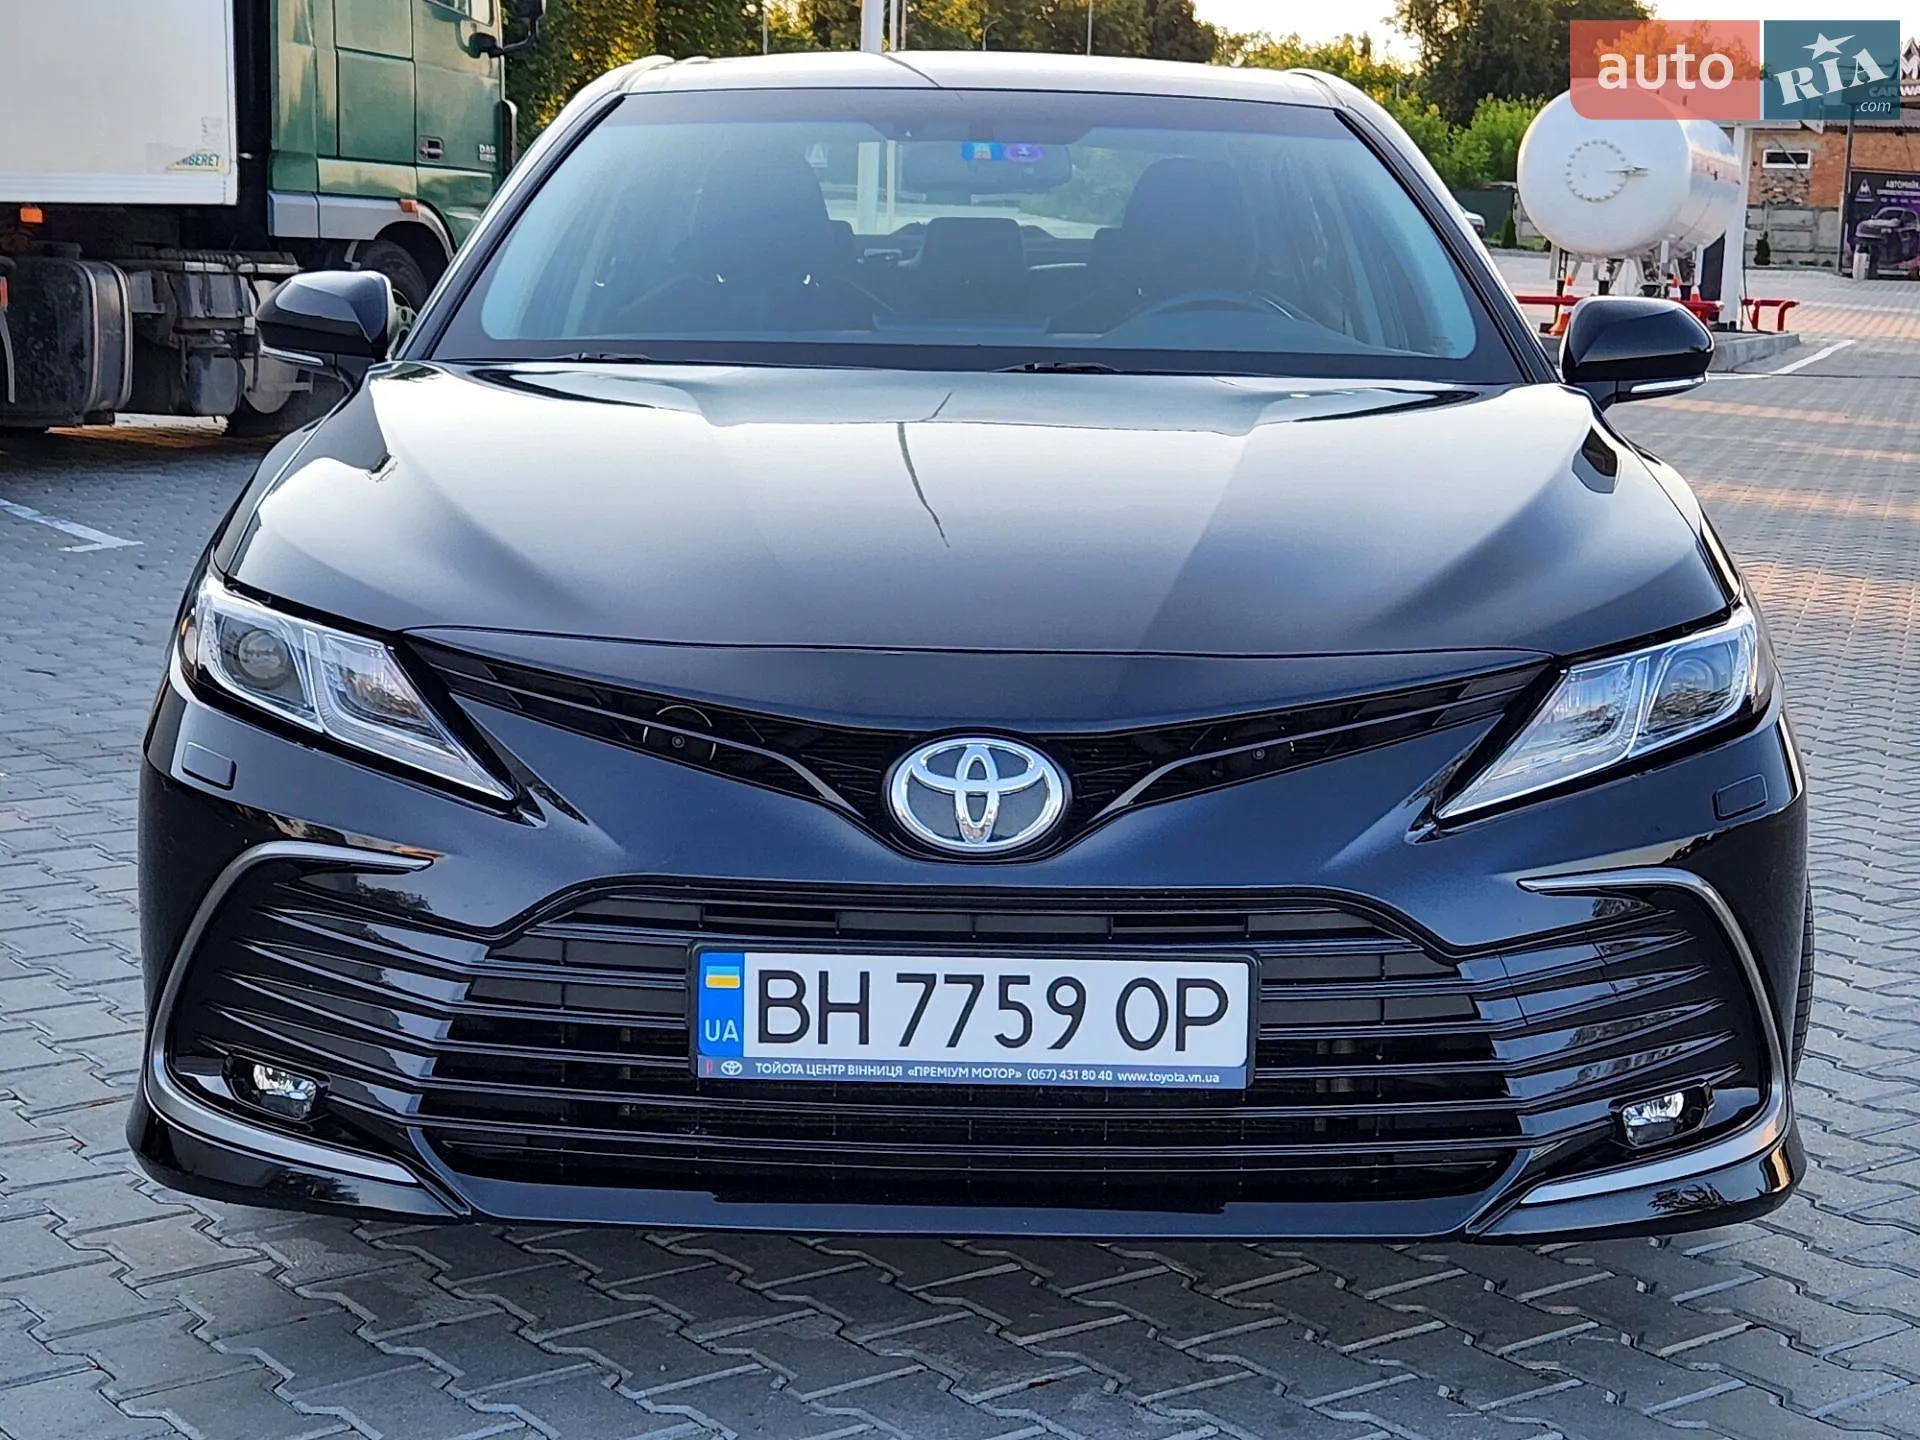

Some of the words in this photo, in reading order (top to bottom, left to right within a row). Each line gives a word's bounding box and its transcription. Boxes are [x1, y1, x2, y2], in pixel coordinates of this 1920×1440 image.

[758, 969, 871, 1046] BH
[896, 972, 1087, 1051] 7759
[1115, 976, 1230, 1052] OP
[705, 1018, 740, 1043] UA
[755, 1061, 805, 1075] ТОЙОТА
[806, 1063, 846, 1077] ЦЕНТР
[847, 1064, 903, 1078] ВІННИЦЯ
[908, 1065, 969, 1079] «ПРЕМІУМ
[971, 1067, 1022, 1079] МОТОР»
[1026, 1068, 1058, 1081] (067)
[1059, 1069, 1079, 1081] 431
[1081, 1069, 1096, 1081] 80
[1098, 1070, 1113, 1081] 40
[1117, 1071, 1221, 1085] www.toyota.vn.ua
